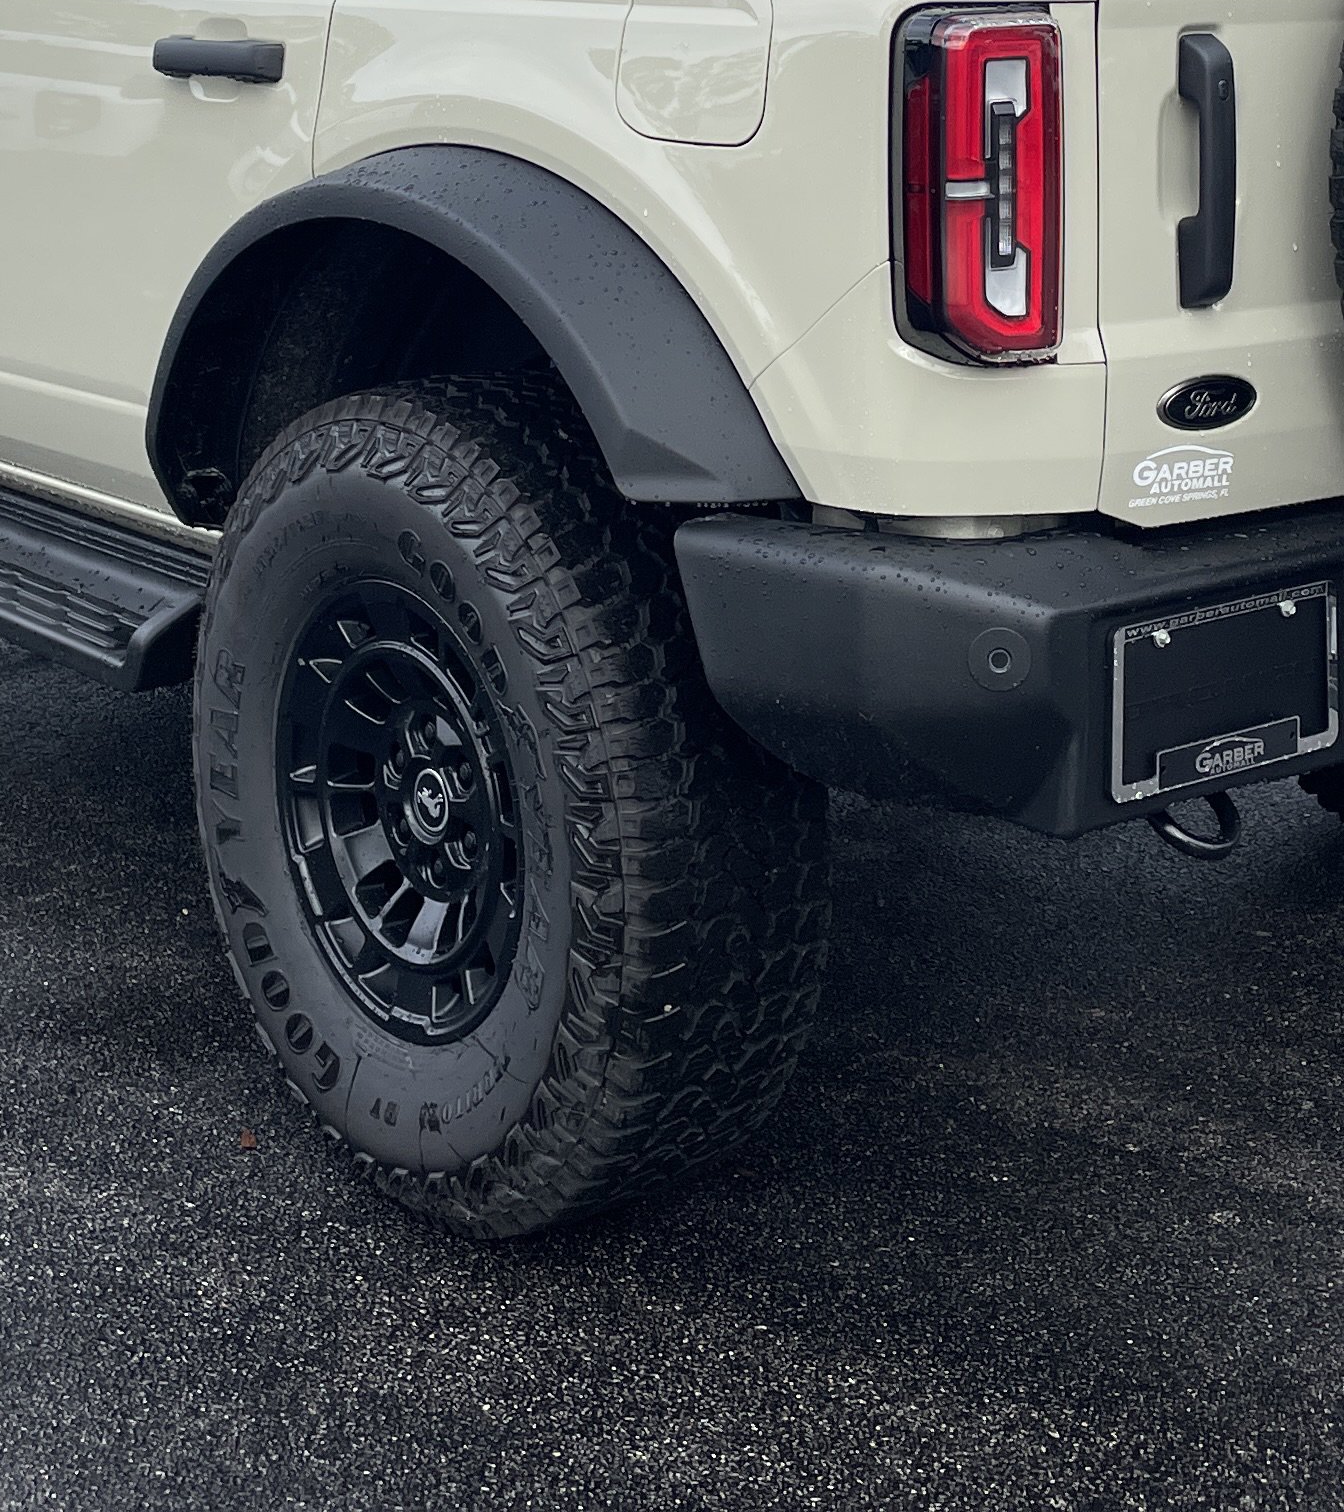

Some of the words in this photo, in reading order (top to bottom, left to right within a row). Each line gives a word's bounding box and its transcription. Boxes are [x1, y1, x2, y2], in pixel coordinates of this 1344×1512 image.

[1184, 388, 1237, 420] Ford
[1133, 456, 1234, 487] GARBER
[1150, 474, 1230, 495] AUTOMALL
[1128, 496, 1158, 508] GREEN
[1158, 493, 1182, 505] COVE
[1219, 488, 1229, 497] FL
[1126, 585, 1324, 638] www.garberautomall.com
[1196, 742, 1264, 773] GARBER
[1210, 757, 1255, 775] AUTOMALL
